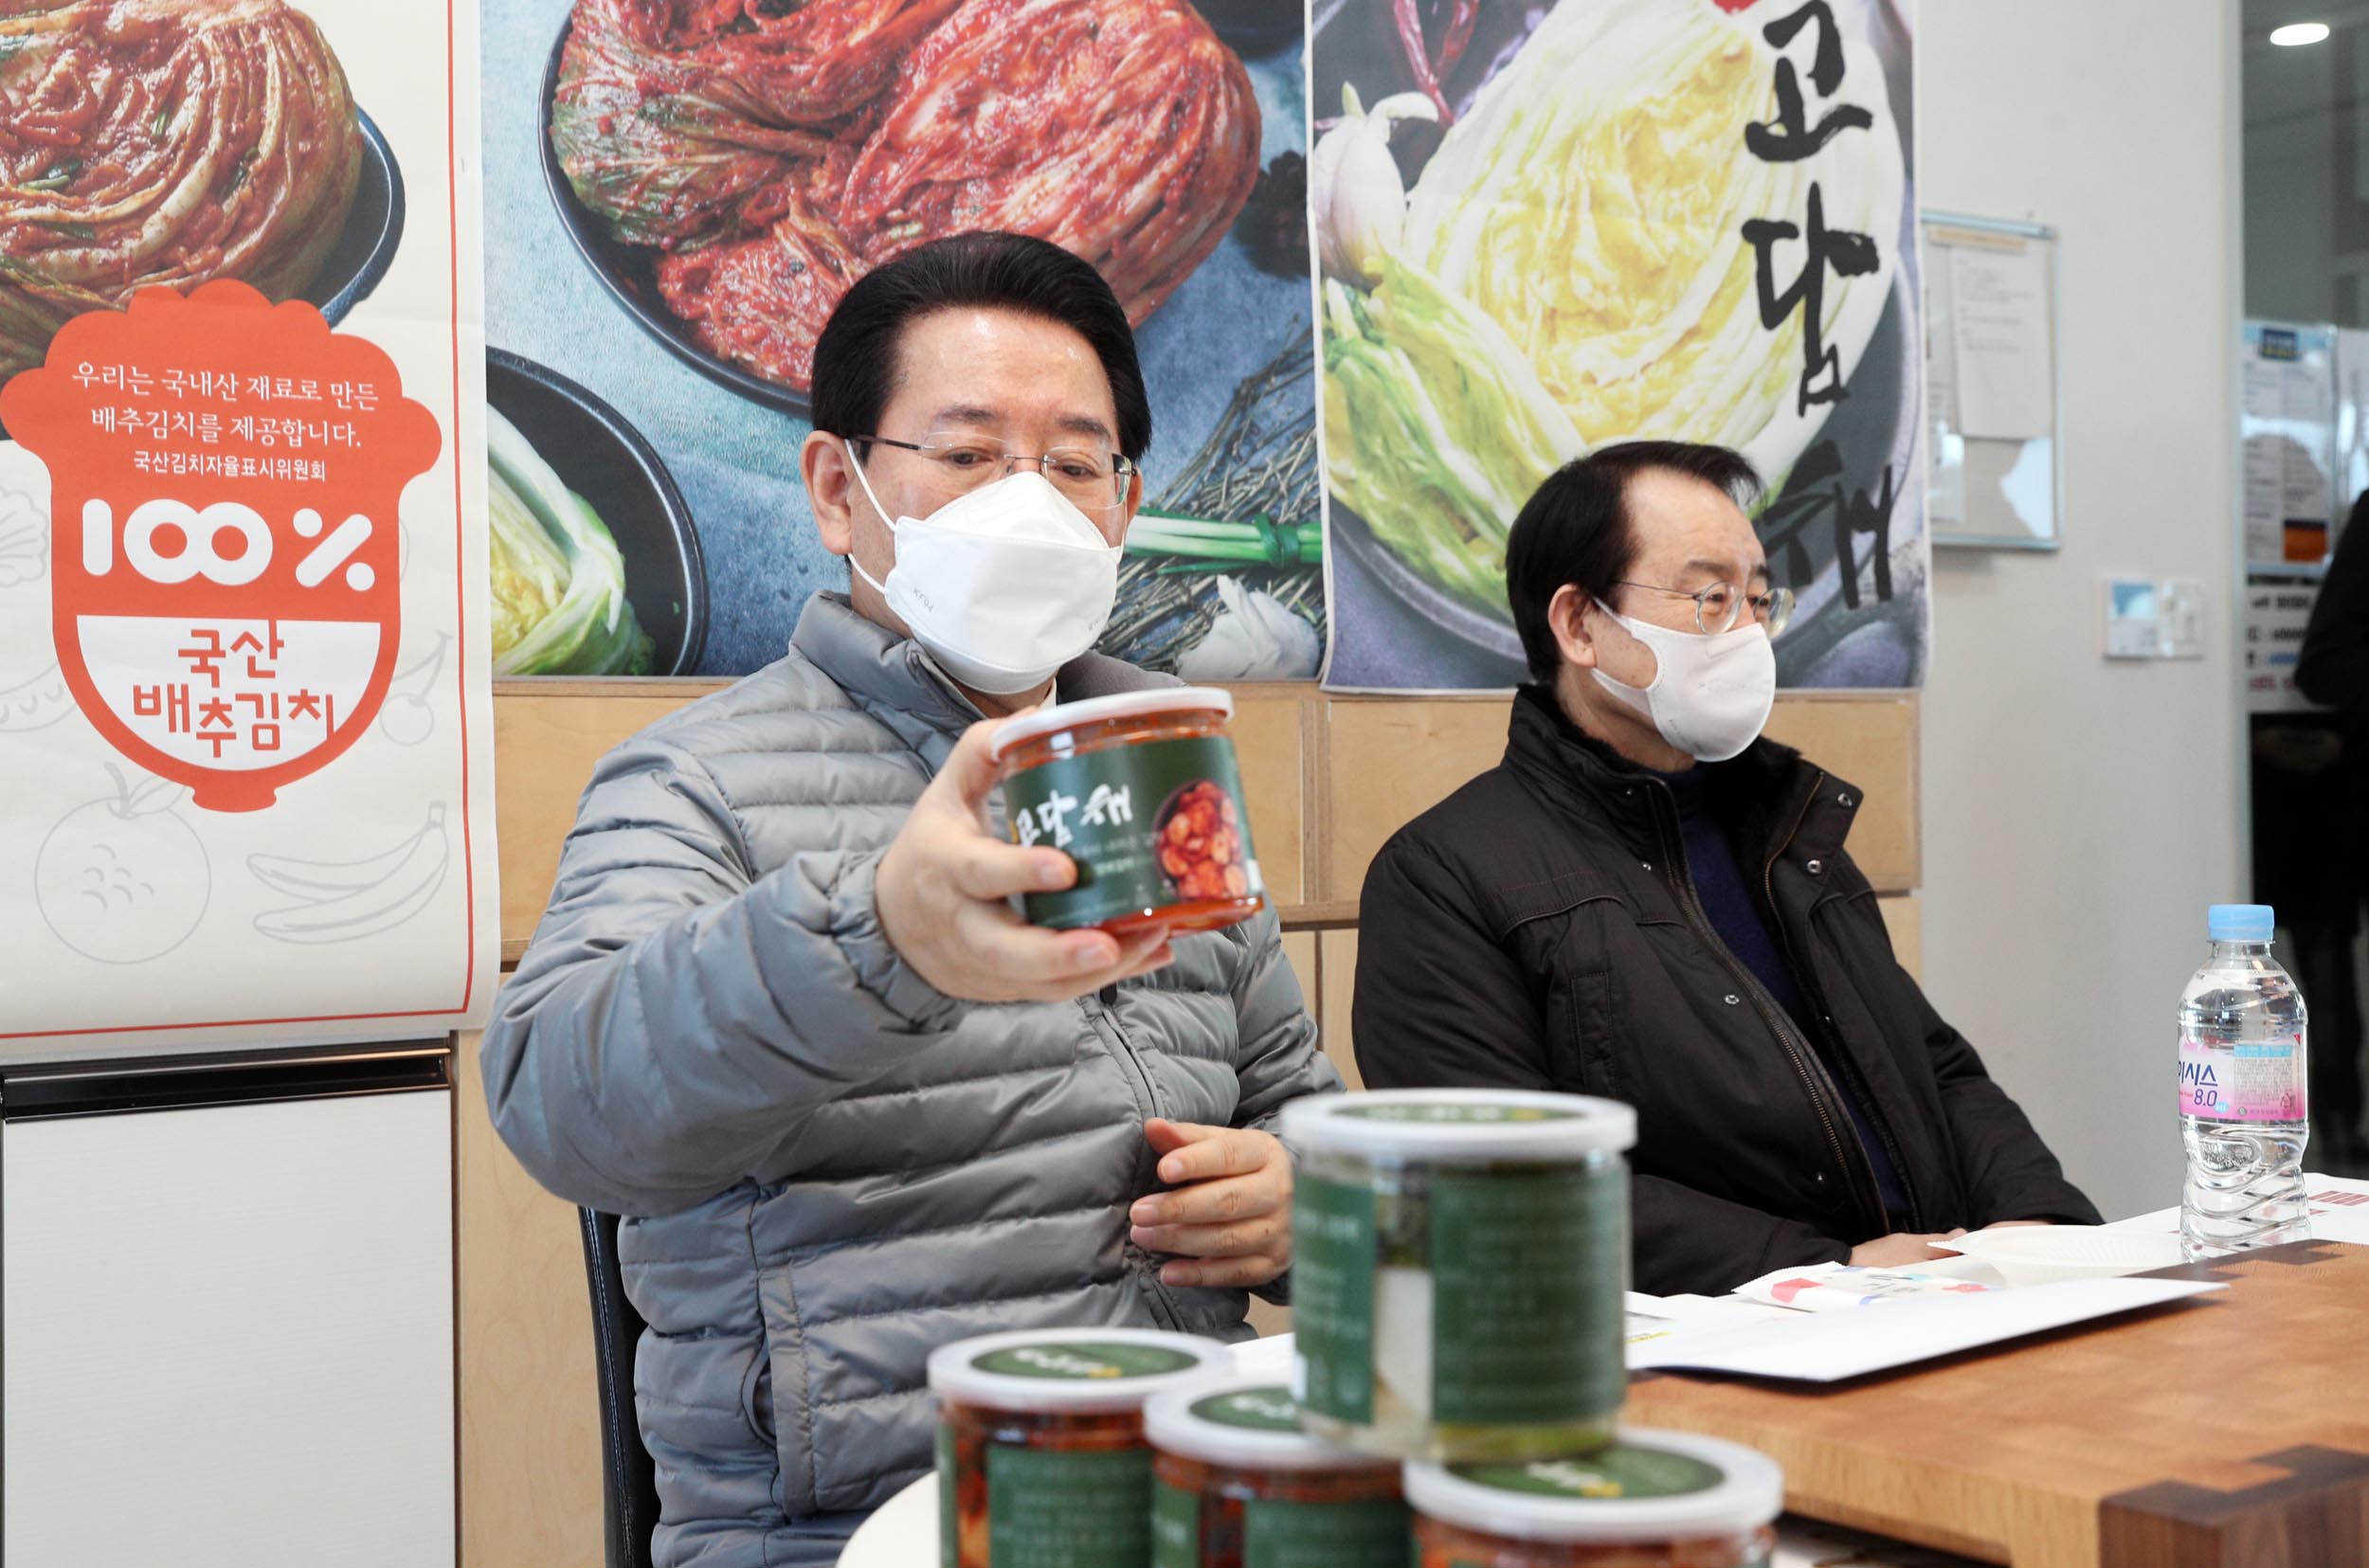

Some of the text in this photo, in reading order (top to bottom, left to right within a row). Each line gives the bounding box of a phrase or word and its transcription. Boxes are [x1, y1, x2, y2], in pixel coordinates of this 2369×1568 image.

[72, 361, 379, 411] 우리는 국내산 재료로 만든
[91, 406, 362, 448] 배추김치를 제공합니다.
[134, 450, 326, 482] 국산김치자율표시위원회
[81, 497, 376, 592] 100%
[177, 620, 285, 689] 국산
[132, 682, 335, 759] 배추김치
[2194, 1088, 2218, 1108] 8.0
